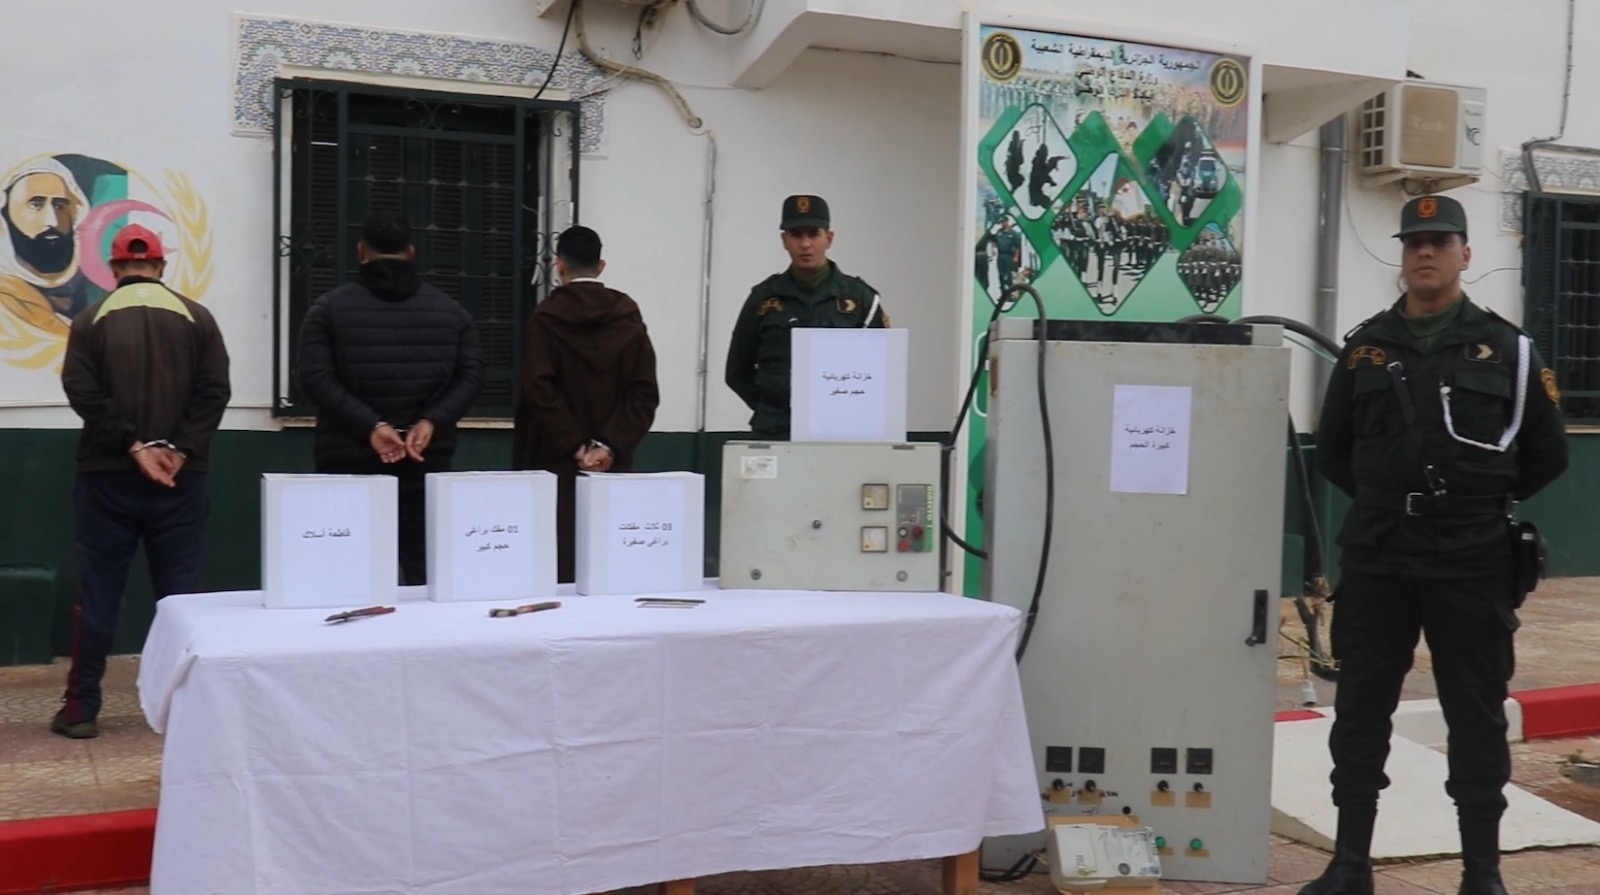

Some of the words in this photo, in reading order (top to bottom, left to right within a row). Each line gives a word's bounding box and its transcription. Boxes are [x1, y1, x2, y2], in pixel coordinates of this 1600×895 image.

[1031, 38, 1064, 54] الشعبية
[1158, 54, 1201, 71] الجمهورية
[853, 371, 873, 382] خزانة
[829, 387, 849, 396] صغير
[850, 388, 866, 397] حجم
[1156, 425, 1176, 436] خزانة
[1129, 440, 1150, 450] الحجم
[1151, 440, 1170, 451] كبيرة
[465, 525, 489, 537] براغي
[490, 524, 506, 534] مفك
[507, 525, 519, 534] 01
[618, 522, 640, 531] مفكات
[661, 522, 673, 531] 03
[328, 528, 351, 538] قاطعة
[476, 542, 492, 552] كبير
[622, 537, 646, 547] صغيرة
[647, 537, 668, 547] براغي
[493, 543, 510, 553] حجم
